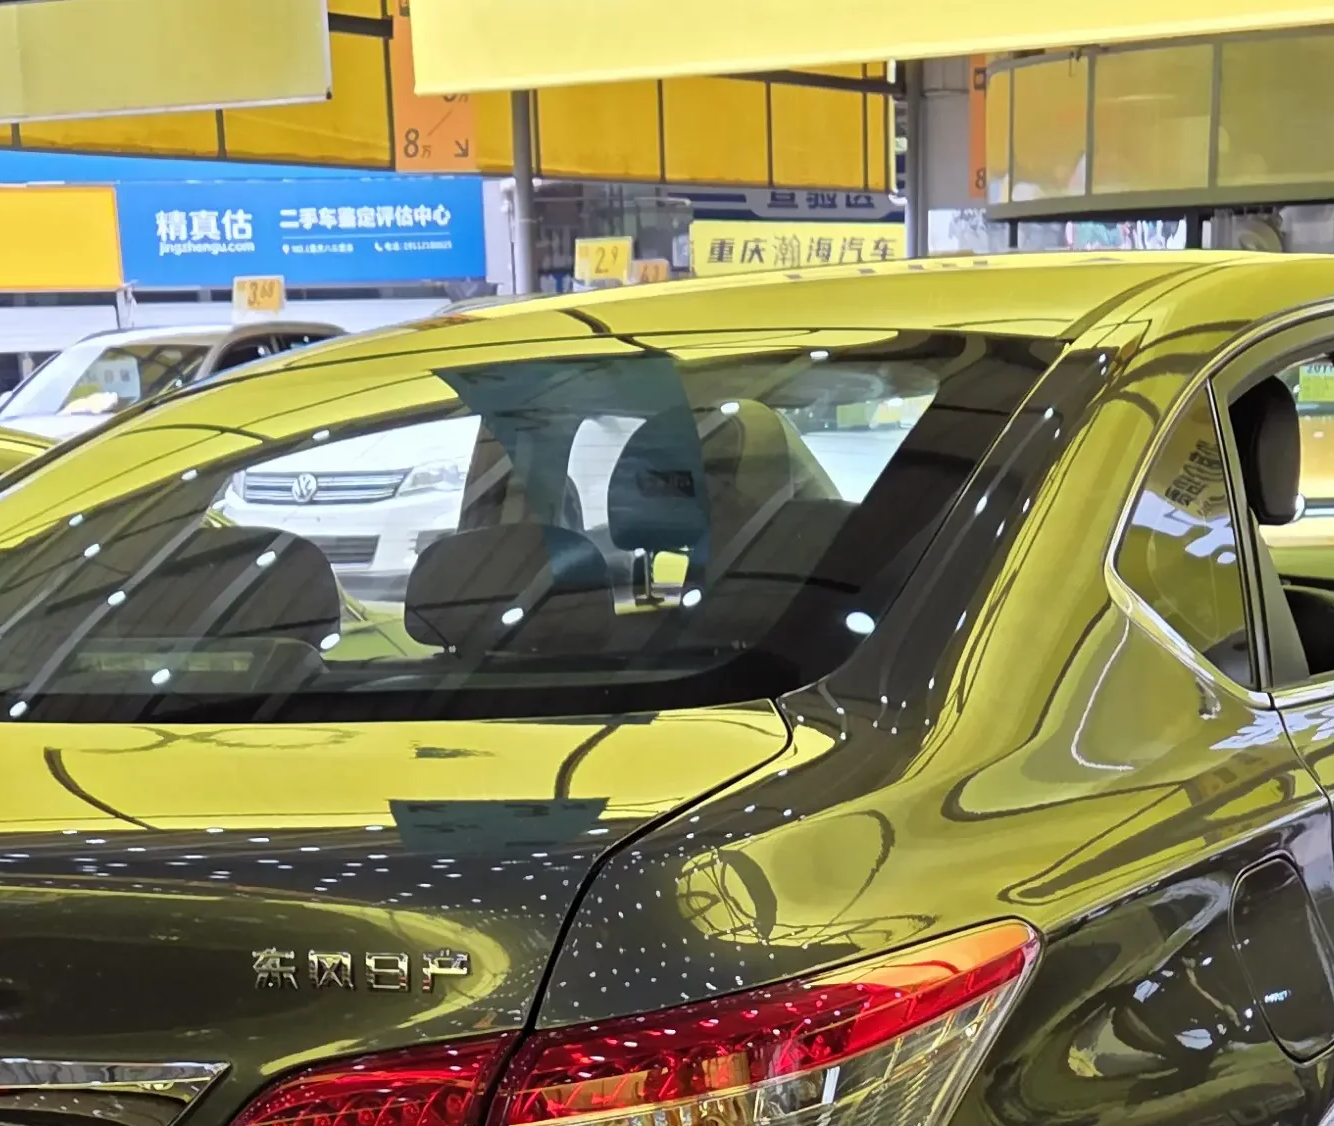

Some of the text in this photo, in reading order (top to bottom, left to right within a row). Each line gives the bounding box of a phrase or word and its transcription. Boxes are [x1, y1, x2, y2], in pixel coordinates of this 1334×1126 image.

[155, 208, 253, 241] 精真估
[707, 234, 897, 267] 重庆瀚海汽车
[252, 946, 469, 994] 东风日产
